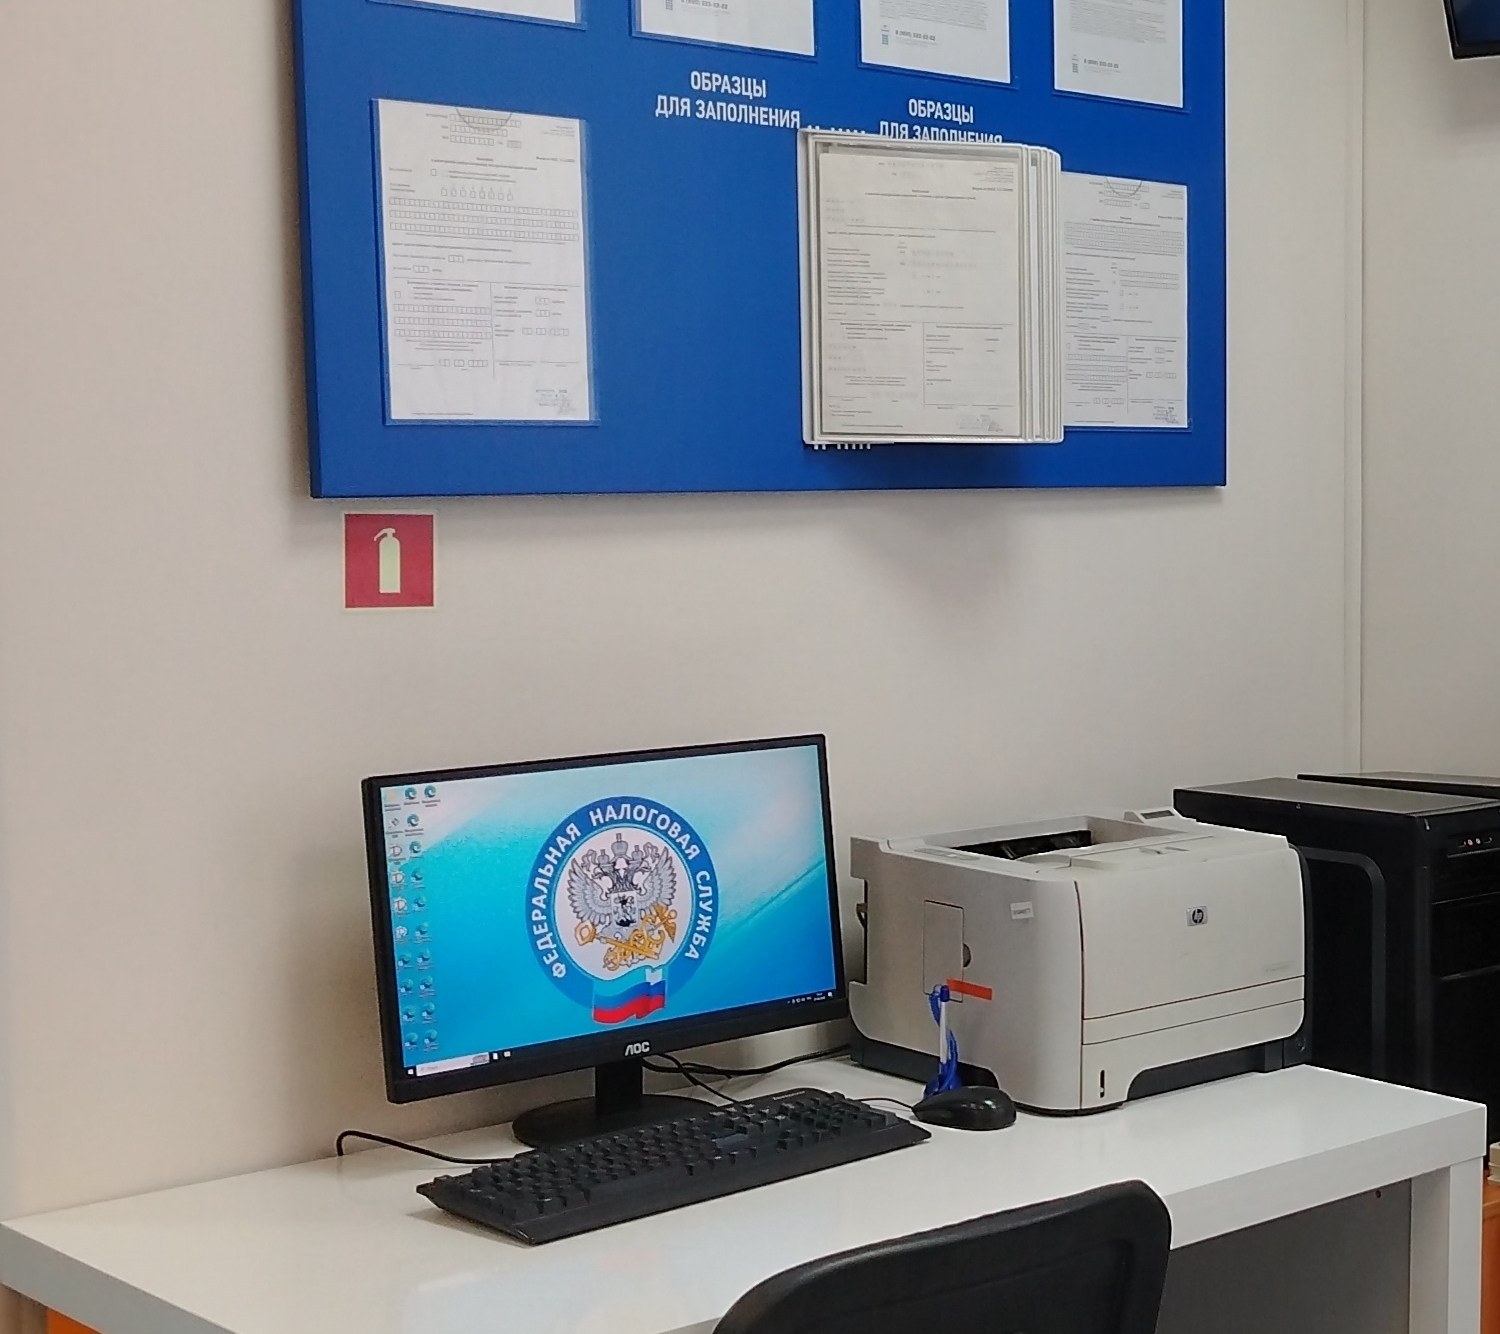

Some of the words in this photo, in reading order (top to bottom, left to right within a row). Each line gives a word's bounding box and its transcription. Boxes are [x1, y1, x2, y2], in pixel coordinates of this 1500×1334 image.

[690, 70, 768, 99] ОБРАЗЦЫ
[655, 95, 691, 118] ДЛЯ
[694, 100, 801, 129] ЗАПОЛНЕНИЯ
[908, 98, 974, 126] ОБРАЗЦЫ
[879, 120, 909, 140] ДЛЯ
[531, 821, 582, 979] ФЕДЕРАЛЬНАЯ
[589, 803, 700, 861] НАЛОГОВАЯ
[684, 870, 713, 962] СЛУЖБА
[624, 1041, 650, 1056] AOC
